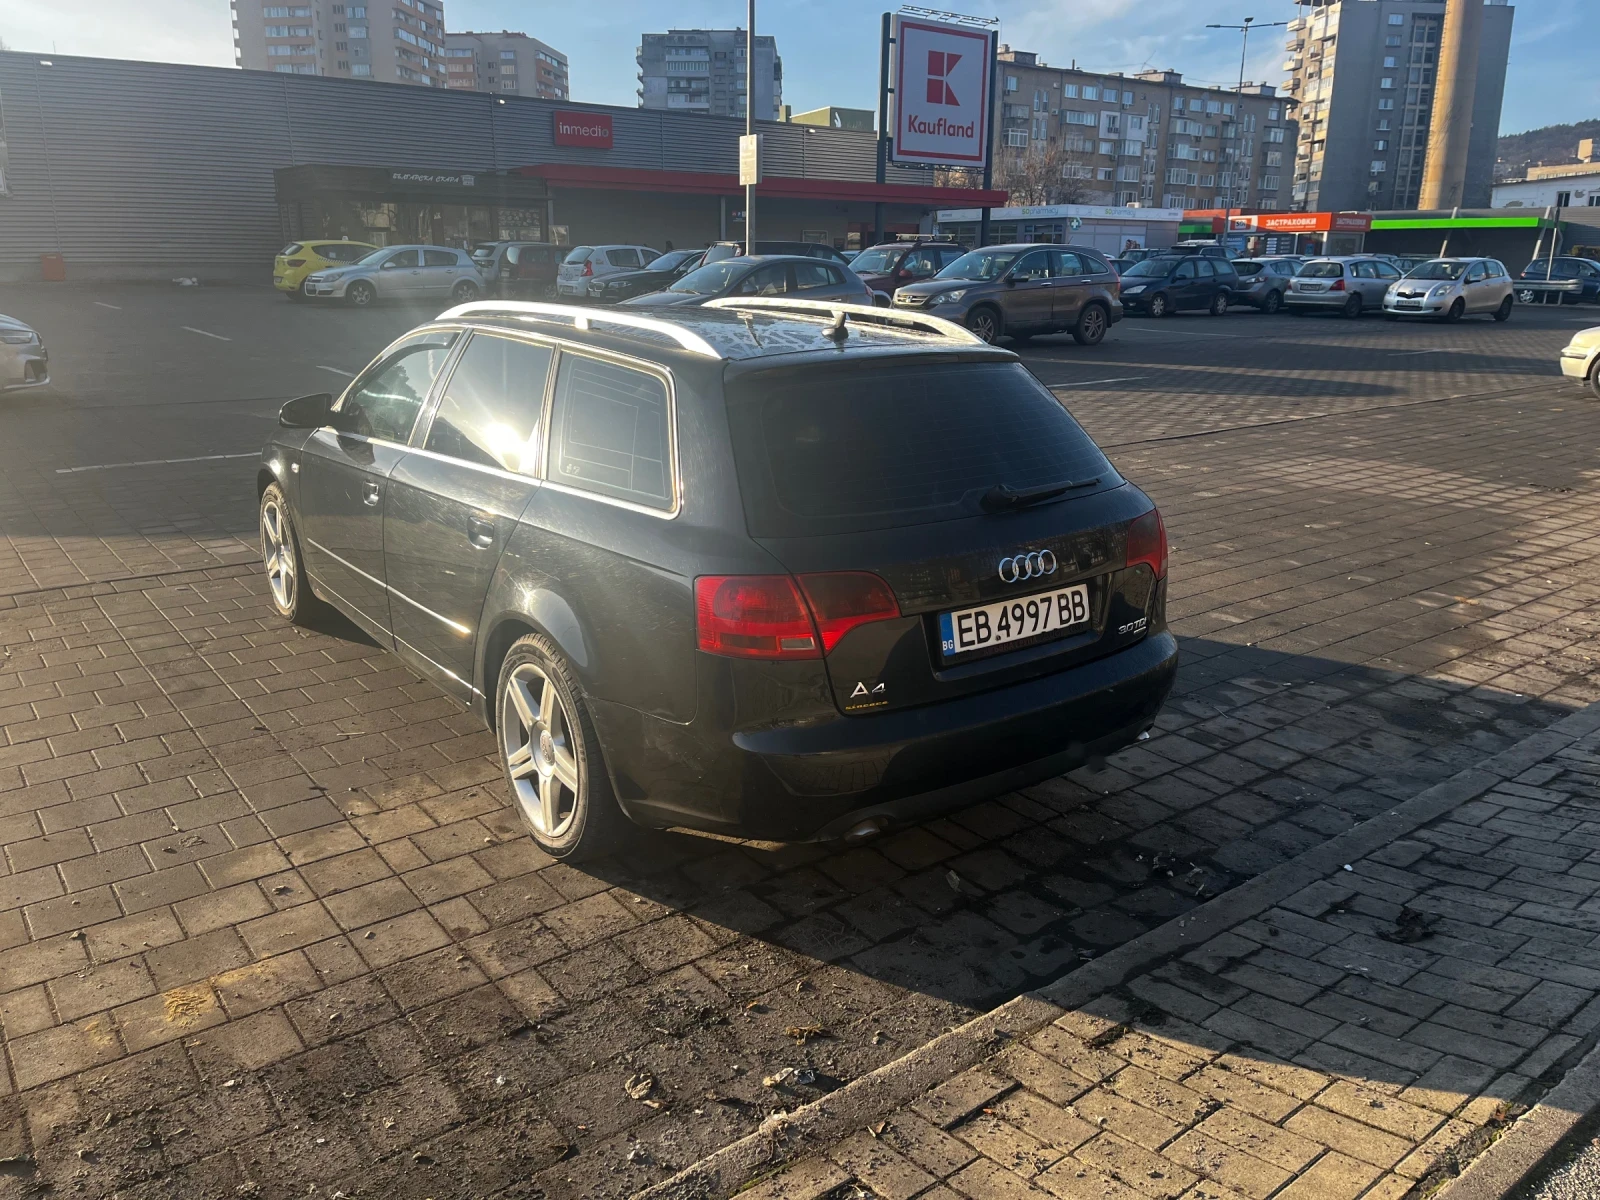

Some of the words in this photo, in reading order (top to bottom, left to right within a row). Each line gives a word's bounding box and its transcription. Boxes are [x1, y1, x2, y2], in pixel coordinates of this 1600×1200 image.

[559, 121, 609, 138] inmedio
[908, 114, 974, 139] Kaufland
[435, 175, 459, 183] СКАРА
[1266, 217, 1317, 226] ЗАСТРАХОВКИ
[942, 639, 954, 651] BG
